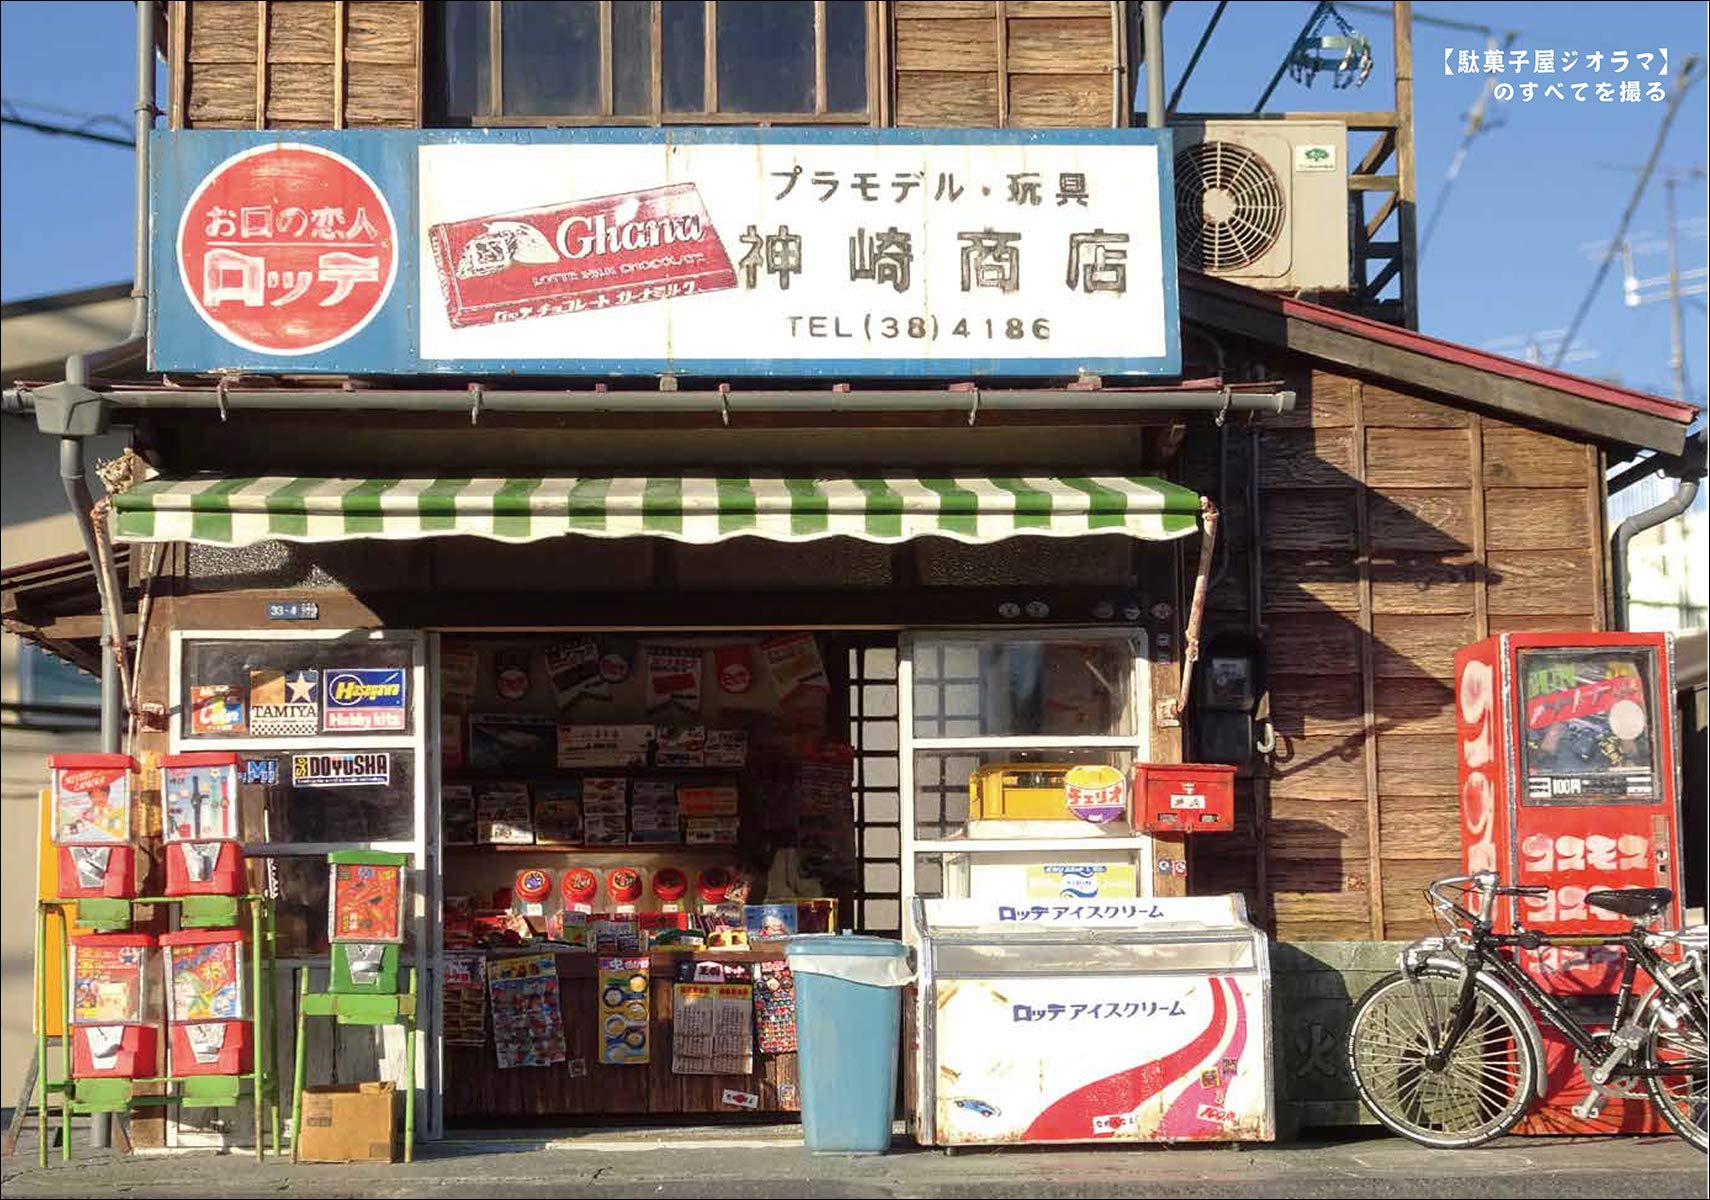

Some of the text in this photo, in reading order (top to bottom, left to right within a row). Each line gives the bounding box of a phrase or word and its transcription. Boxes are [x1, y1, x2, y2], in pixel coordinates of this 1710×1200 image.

[771, 166, 1090, 206] プラモデル・玩具
[204, 206, 379, 240] お口の恋人
[556, 211, 704, 259] Ghana
[738, 225, 1130, 293] 神崎商店
[203, 250, 381, 308] ロッテ
[251, 705, 317, 718] TAMIYA
[310, 754, 387, 776] DOYUSHA
[1069, 786, 1121, 805] チェリオ
